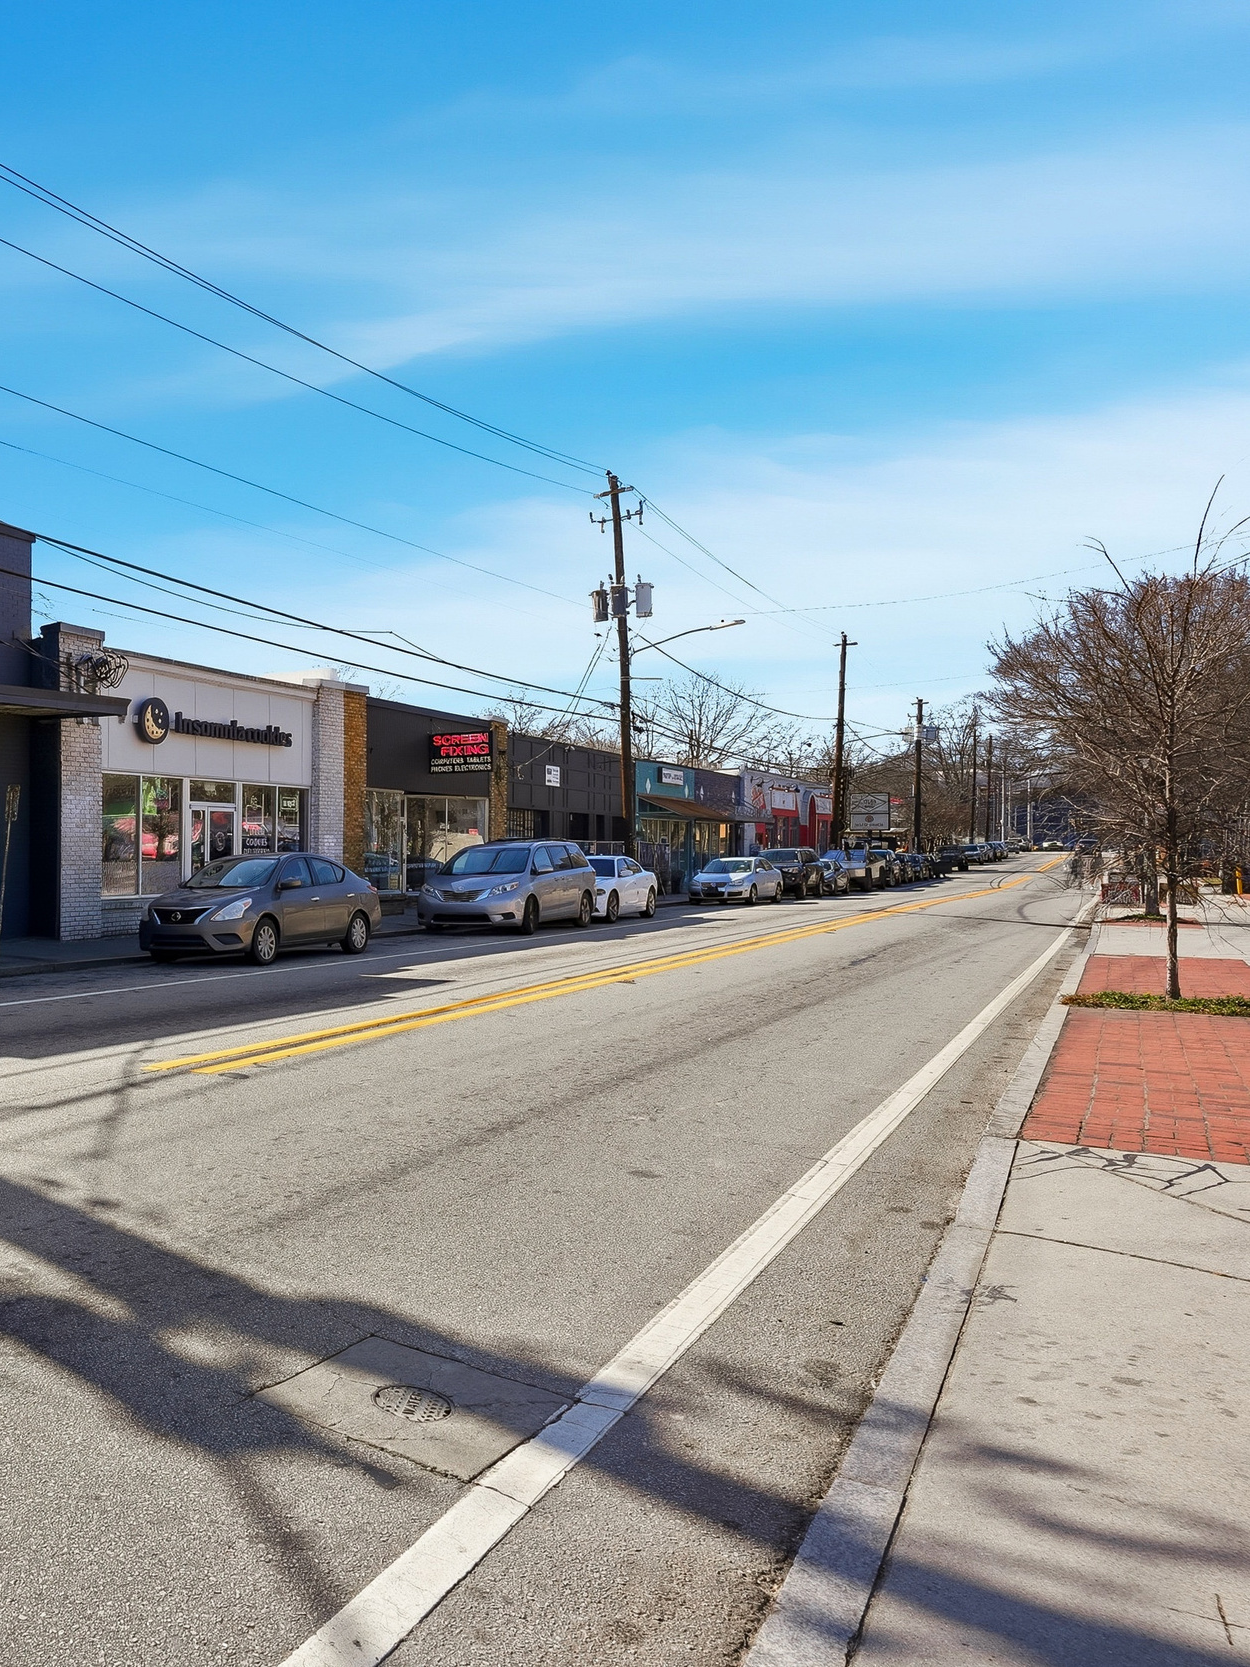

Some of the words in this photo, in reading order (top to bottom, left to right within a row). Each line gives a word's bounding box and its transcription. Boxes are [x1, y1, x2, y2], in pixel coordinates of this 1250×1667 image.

[432, 732, 489, 746] SCREEN
[440, 743, 490, 756] FIXING
[454, 763, 492, 772] ELECTRONICS
